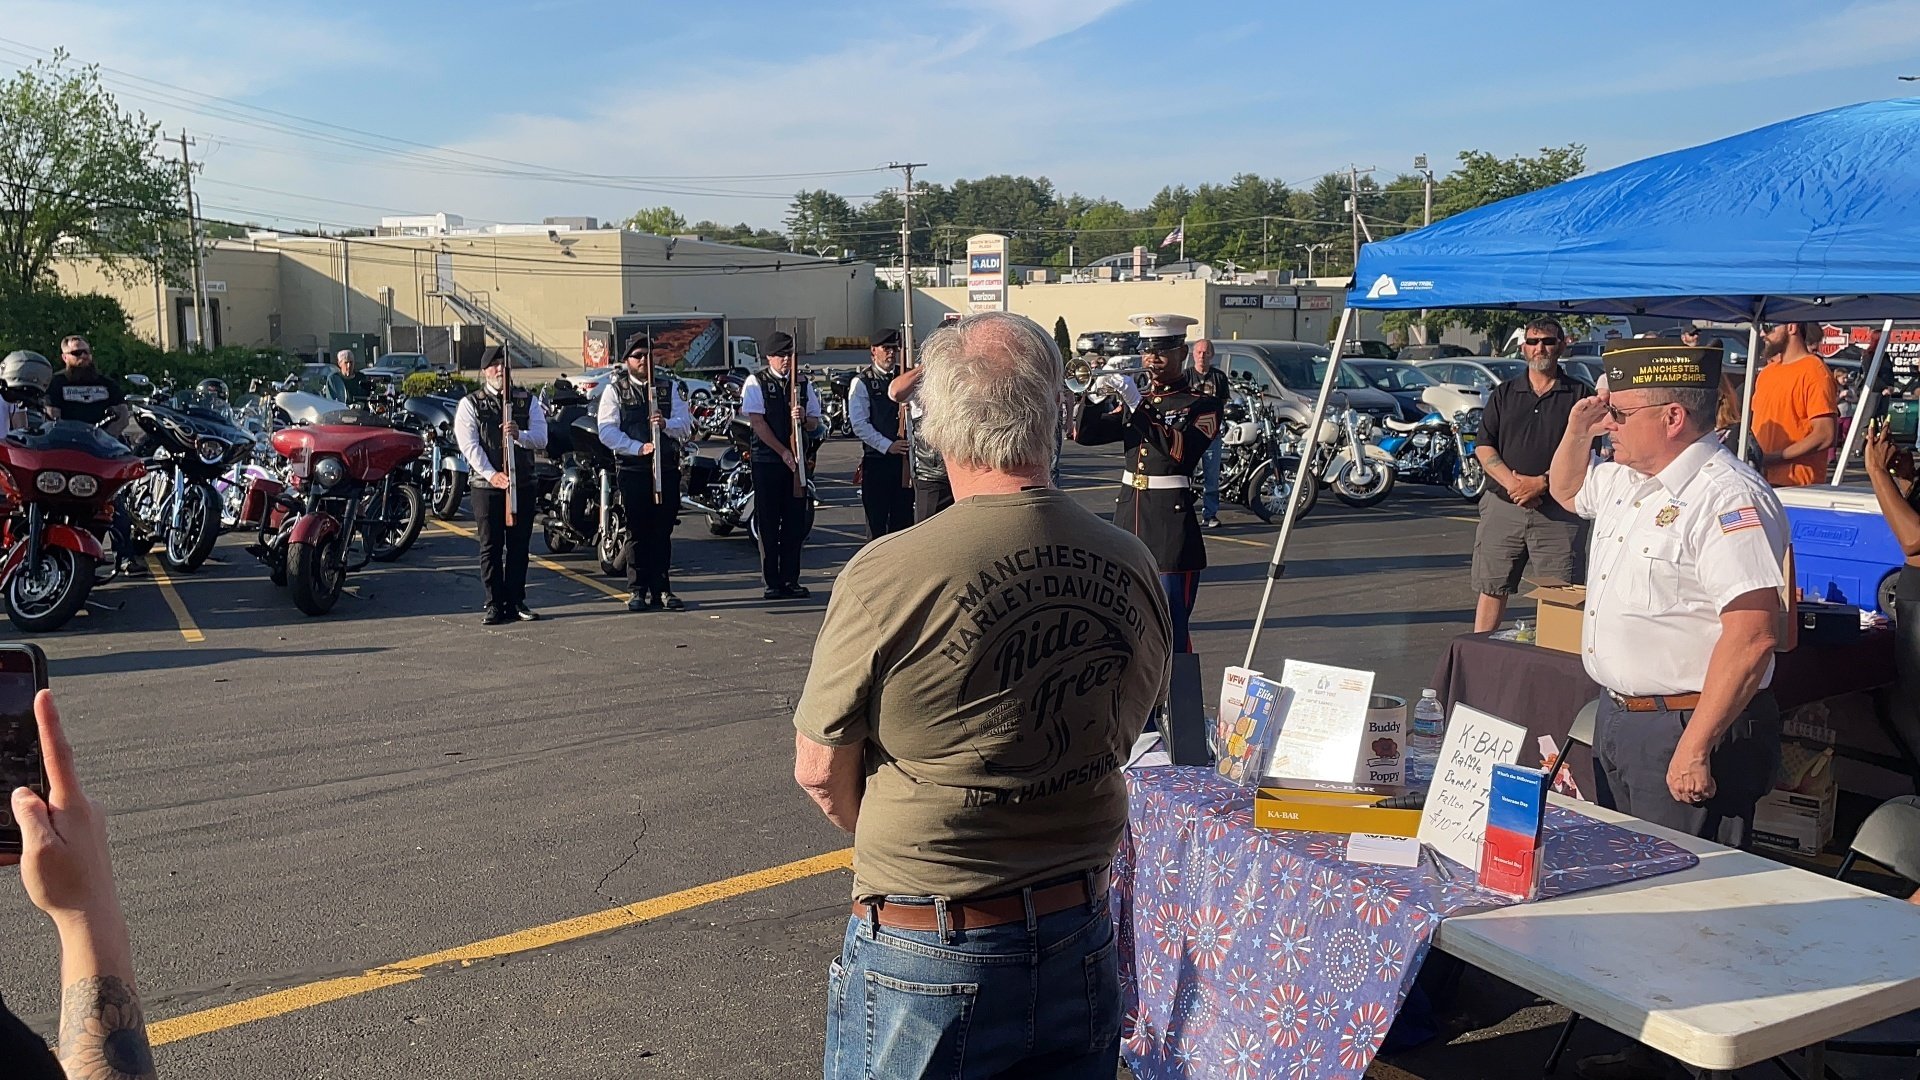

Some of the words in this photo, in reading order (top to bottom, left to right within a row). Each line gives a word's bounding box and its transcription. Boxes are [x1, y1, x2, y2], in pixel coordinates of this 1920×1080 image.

[980, 258, 1000, 268] ALDI
[972, 292, 996, 301] verizon
[1639, 364, 1700, 375] MANCHESTER
[1632, 374, 1653, 384] NEW
[1655, 373, 1706, 383] HAMPSHIRE
[954, 544, 1132, 614] MANCHESTER
[940, 575, 1146, 665] HARLEY-DAVIDSON
[993, 611, 1090, 689] Ride
[1227, 673, 1246, 685] VFW
[1031, 659, 1113, 732] Free
[1256, 687, 1274, 701] Elite
[1369, 721, 1401, 733] Buddy
[1458, 723, 1513, 763] K-BAR
[1451, 750, 1482, 775] Raffle
[1020, 753, 1119, 800] HAMPSHIRE
[1369, 771, 1400, 783] Poppy
[1444, 770, 1478, 792] Benefit
[1315, 783, 1375, 792] KA-BAR
[963, 789, 1013, 808] NEW
[1438, 790, 1464, 810] Fallen
[1501, 795, 1520, 805] Veterans
[1267, 810, 1299, 820] KA-BAR
